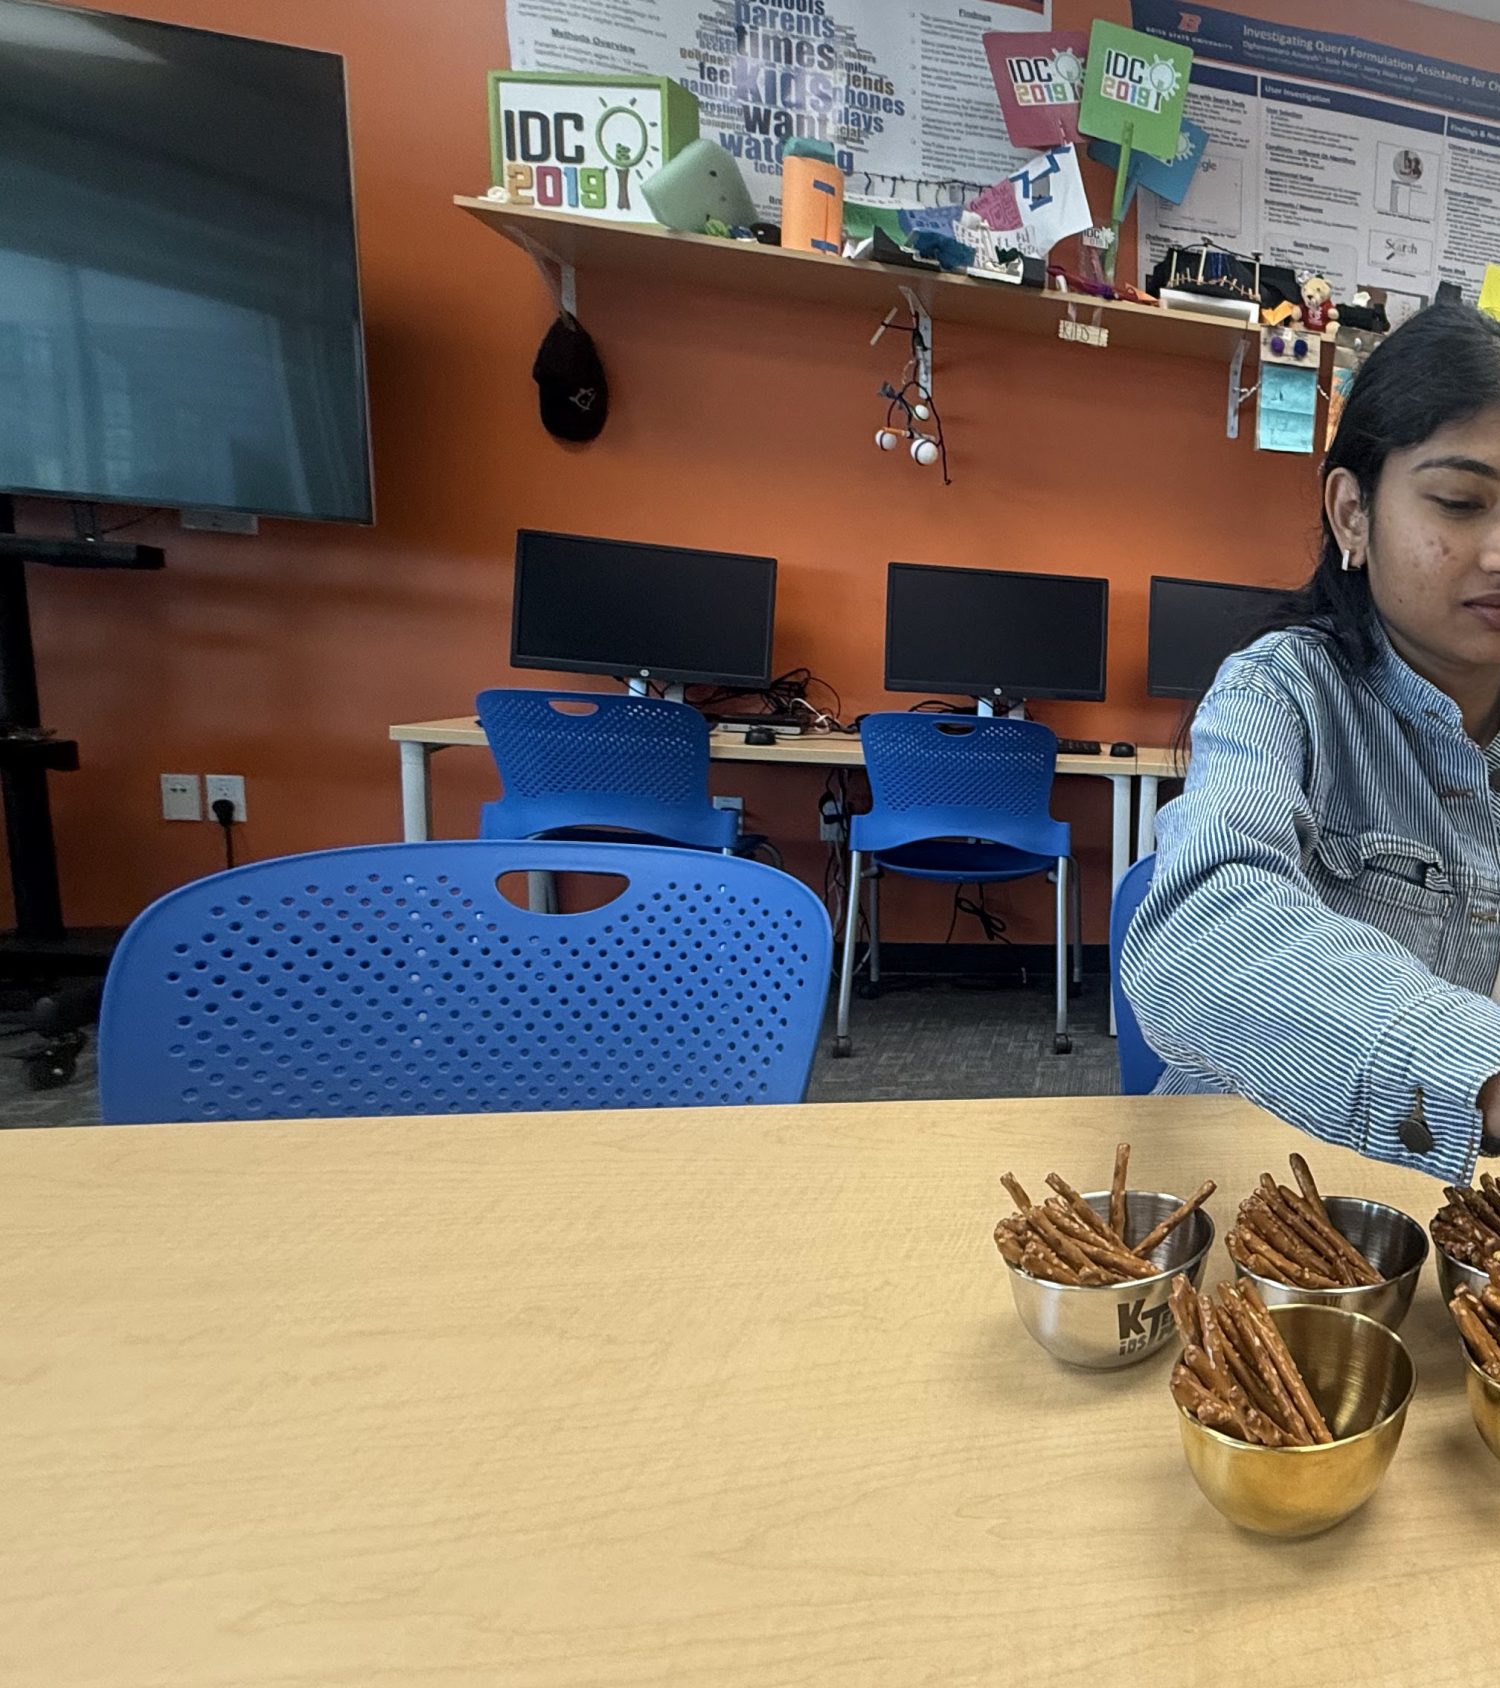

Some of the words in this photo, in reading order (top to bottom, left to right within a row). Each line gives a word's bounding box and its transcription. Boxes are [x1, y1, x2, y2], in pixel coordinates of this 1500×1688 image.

[736, 2, 834, 39] parents
[755, 0, 825, 15] chools
[737, 26, 834, 71] times
[1243, 24, 1313, 50] Investigating
[1315, 40, 1348, 58] Query
[1350, 46, 1414, 71] Formulation
[1416, 63, 1469, 85] Assistance
[1471, 76, 1485, 88] for
[1007, 57, 1053, 83] IDC
[1105, 49, 1145, 85] IDC
[1015, 82, 1069, 104] 2019
[1101, 78, 1151, 107] 2019
[504, 109, 585, 164] IDC
[506, 163, 607, 210] 2019
